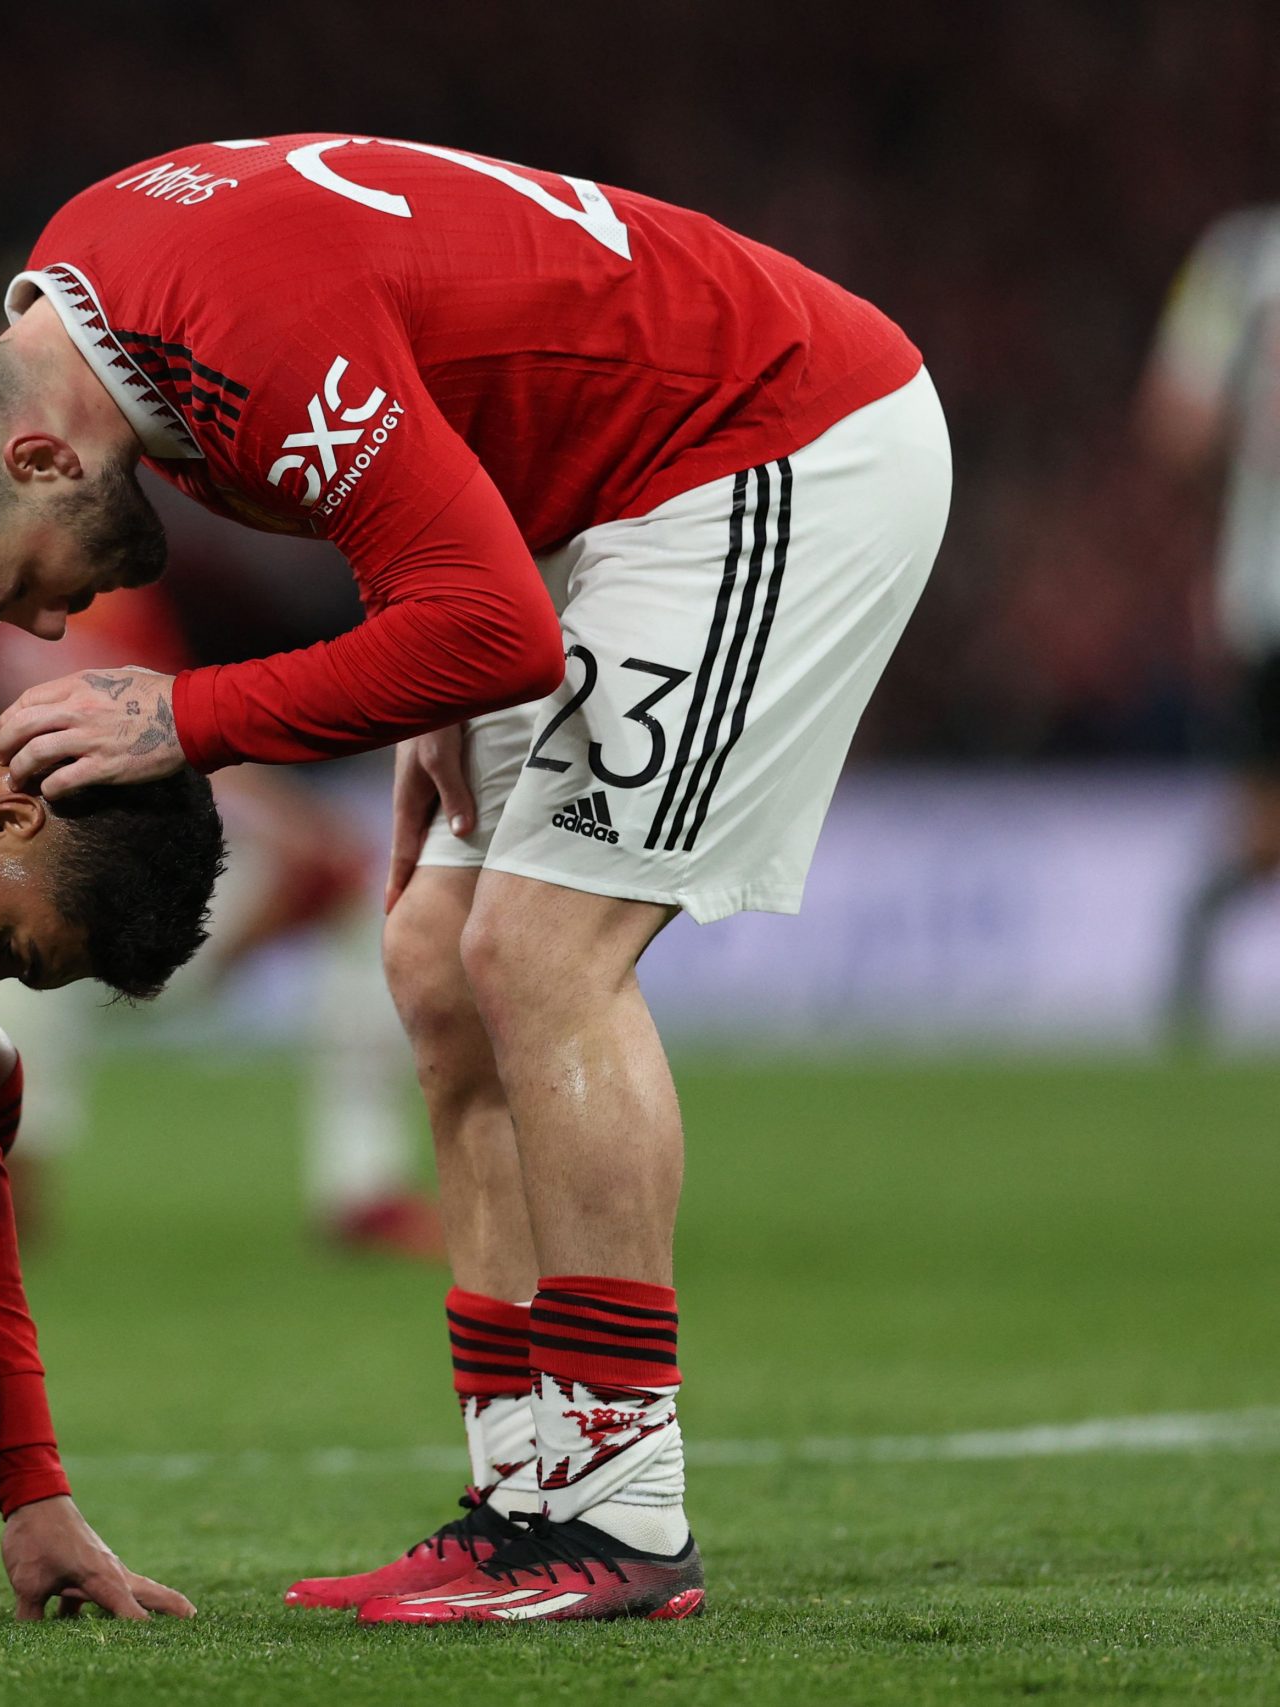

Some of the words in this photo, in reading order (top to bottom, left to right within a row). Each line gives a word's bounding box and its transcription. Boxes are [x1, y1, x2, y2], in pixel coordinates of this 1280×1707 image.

[116, 162, 238, 205] SHAW
[212, 138, 632, 261] 2
[266, 354, 387, 507] DXC
[126, 700, 141, 716] 23
[526, 644, 692, 789] 23
[551, 813, 620, 845] adidas
